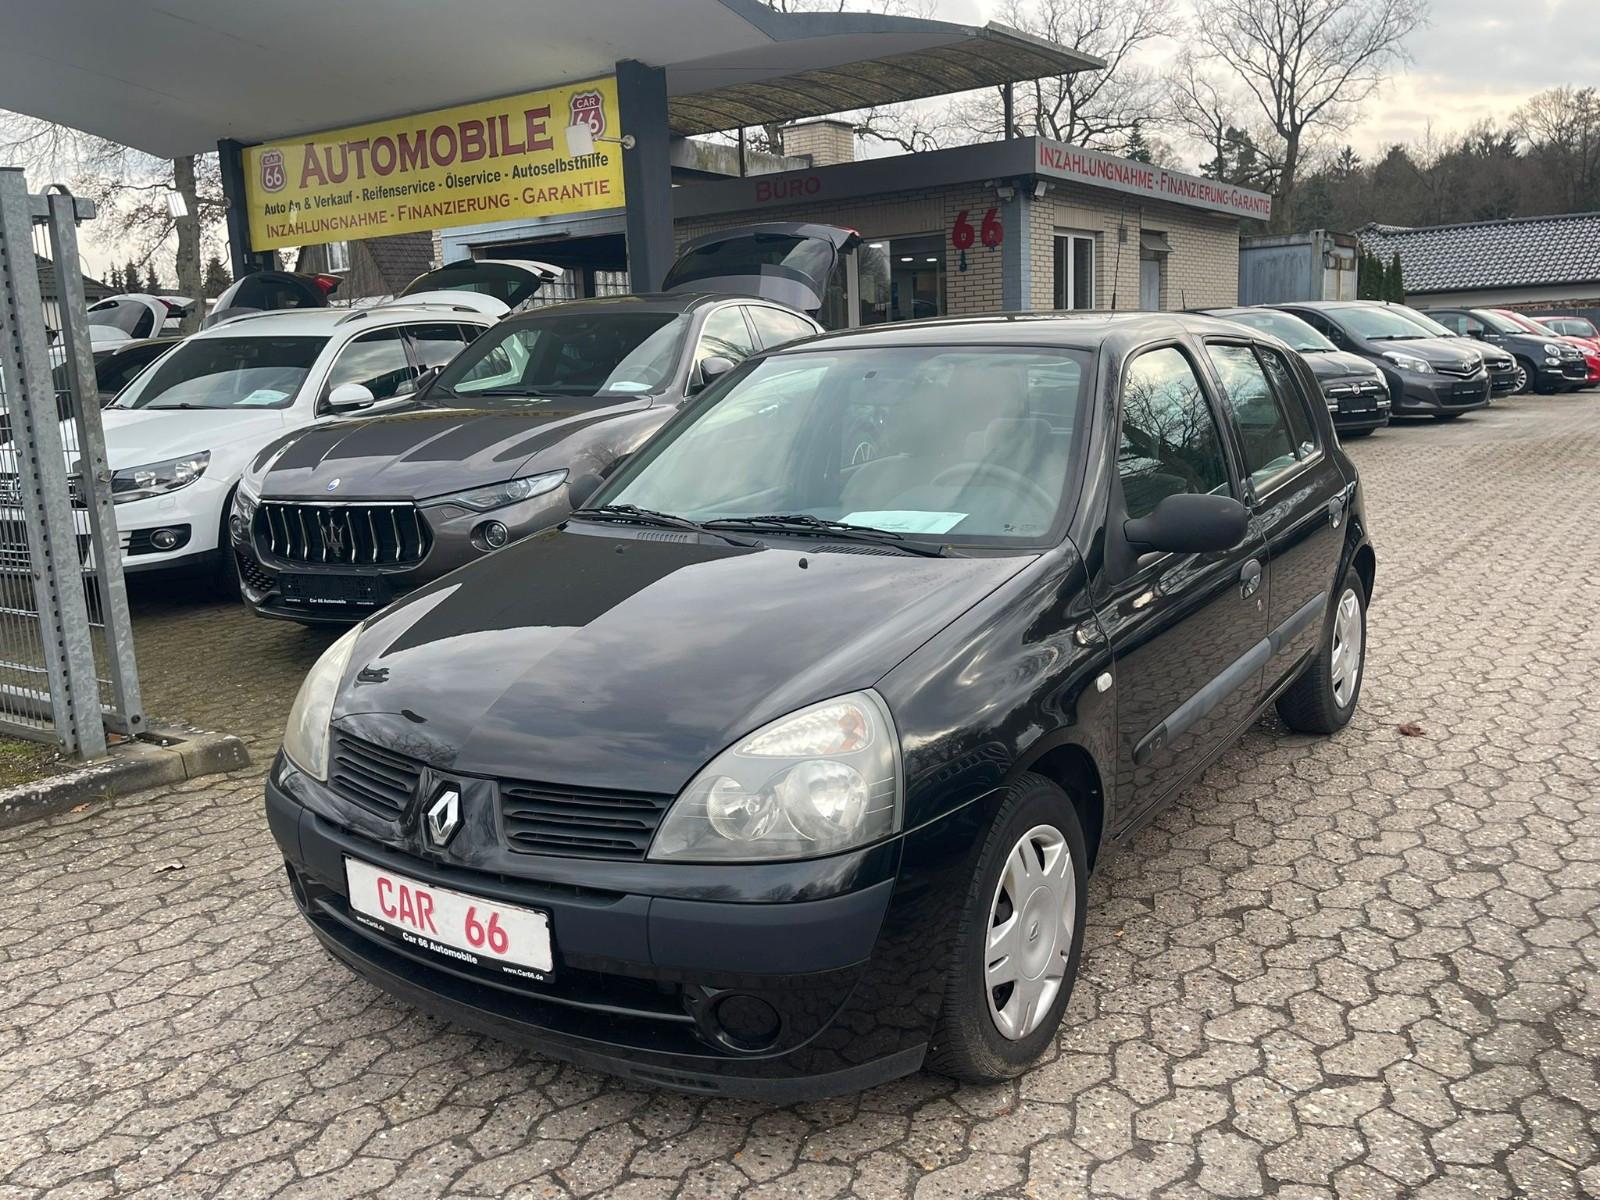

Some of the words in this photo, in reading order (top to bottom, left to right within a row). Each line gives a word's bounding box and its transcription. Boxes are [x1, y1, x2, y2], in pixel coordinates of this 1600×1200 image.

[576, 97, 596, 108] CAR
[299, 104, 554, 189] AUTOMOBILE
[1040, 142, 1154, 190] INZAHLUNGNAHME
[264, 203, 286, 216] Auto
[288, 200, 301, 213] An
[304, 197, 312, 210] &
[313, 190, 353, 209] Verkauf
[362, 179, 436, 202] Reifenservice
[445, 169, 501, 189] Ölservice
[512, 152, 609, 180] Autoselbsthilfe
[265, 167, 282, 187] 66
[755, 175, 822, 202] BÜRO
[266, 210, 388, 239] INZAHLUNGNAHME
[398, 193, 510, 221] FINANZIERUNG
[522, 179, 611, 204] GARANTIE
[377, 877, 439, 935] CAR
[464, 906, 509, 954] 66
[402, 932, 417, 944] Car
[418, 937, 428, 948] 66
[430, 943, 478, 964] Automobile
[502, 966, 544, 981] www.Car66.de
